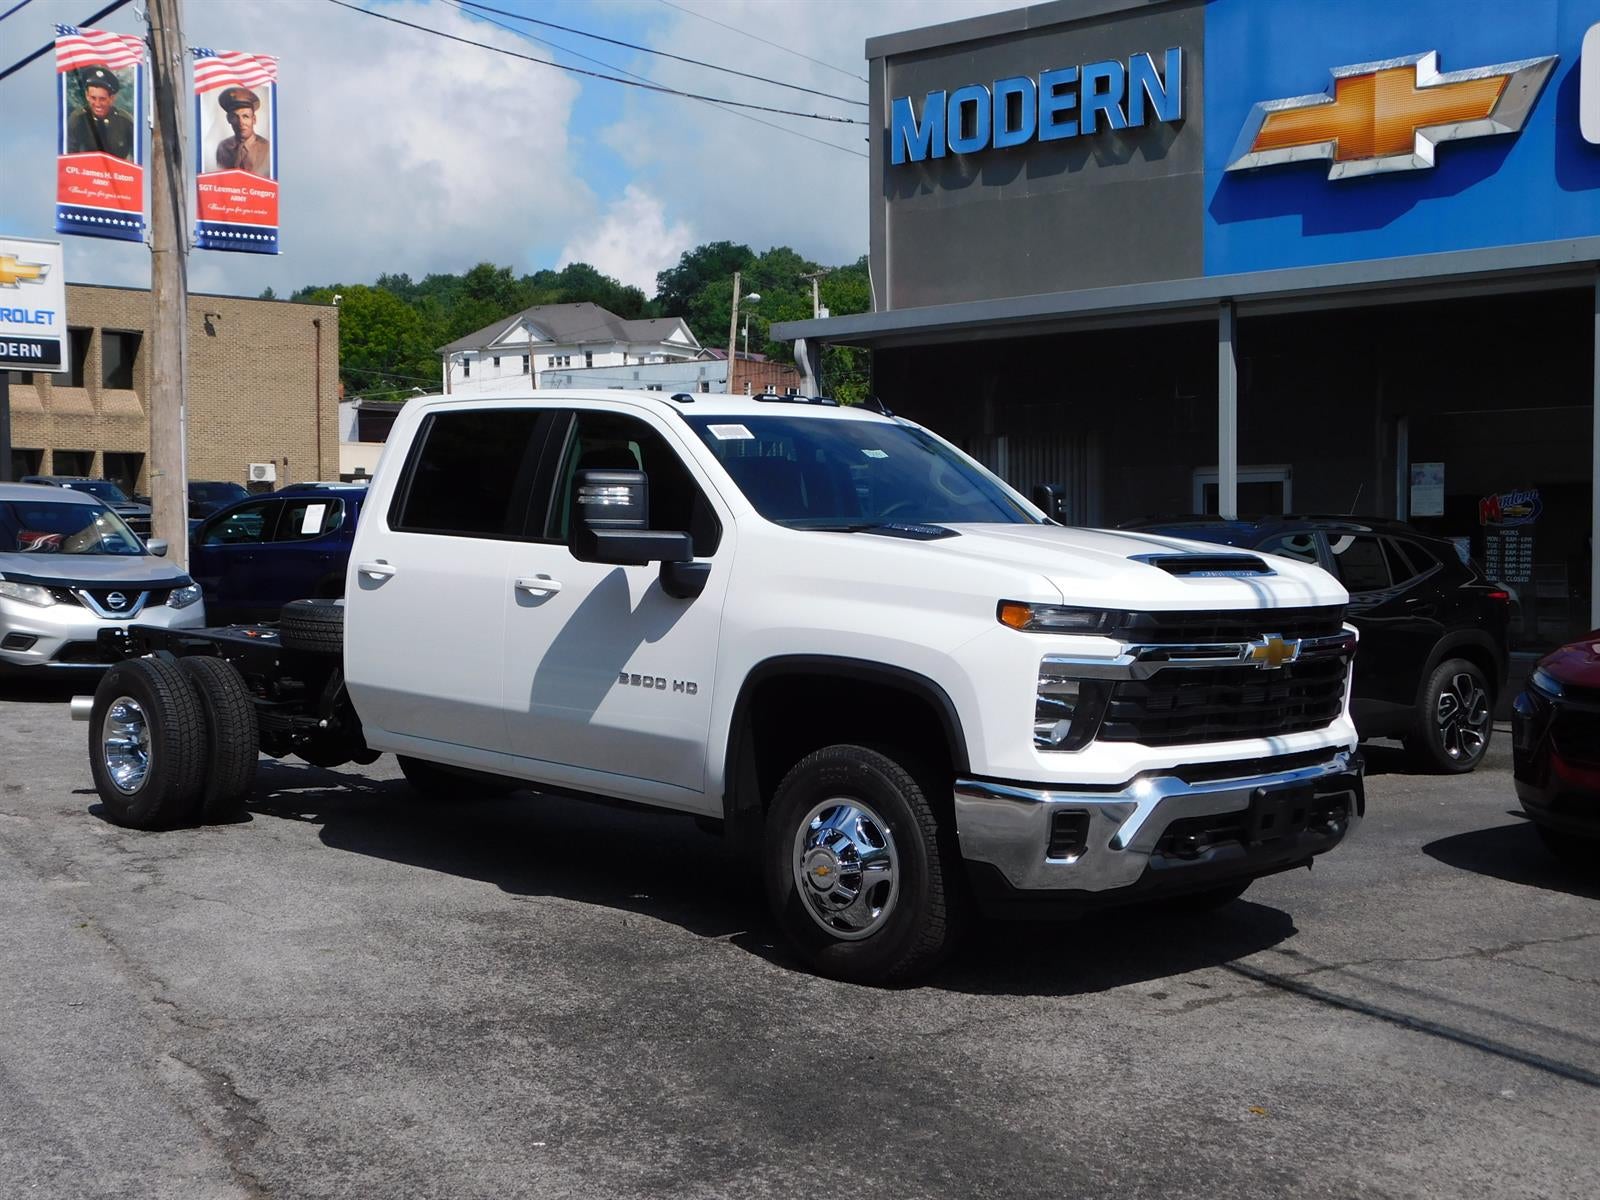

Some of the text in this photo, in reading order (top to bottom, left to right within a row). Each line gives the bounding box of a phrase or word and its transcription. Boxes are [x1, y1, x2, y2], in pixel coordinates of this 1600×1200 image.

[890, 46, 1183, 166] MODERN
[82, 169, 104, 178] James
[113, 173, 134, 182] Eaton
[249, 188, 275, 198] Gregory
[618, 672, 698, 695] 3500 HD
